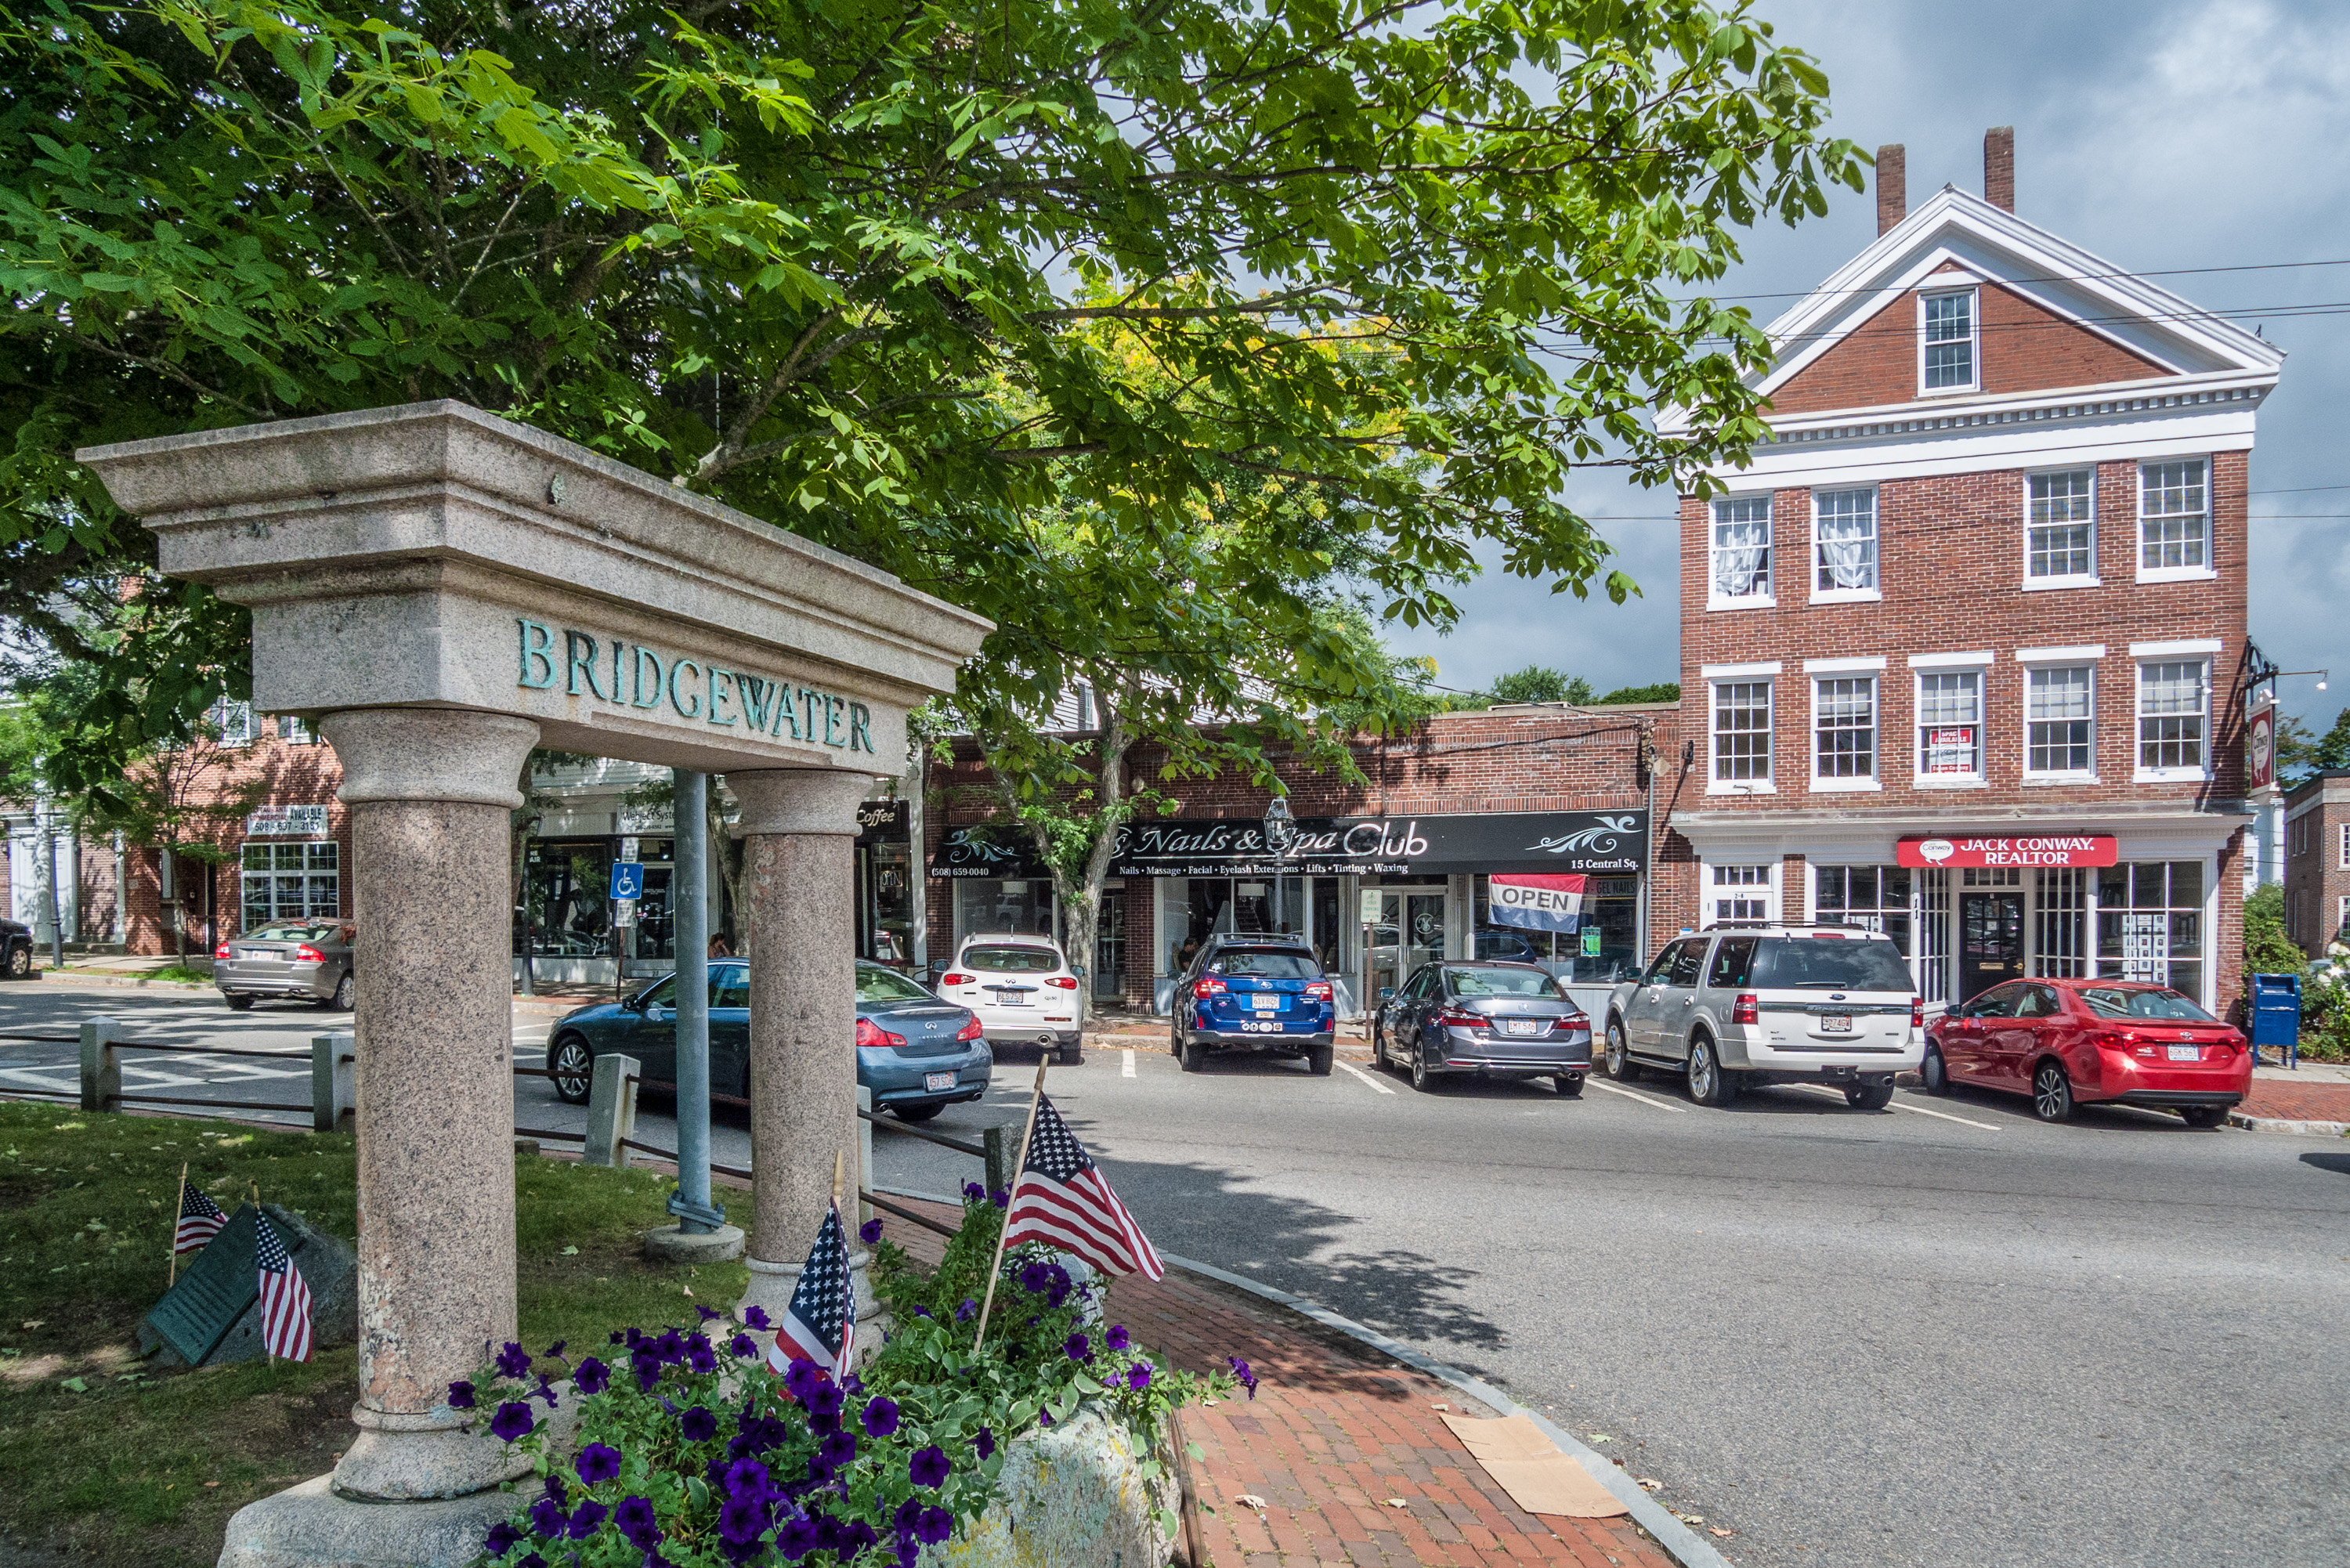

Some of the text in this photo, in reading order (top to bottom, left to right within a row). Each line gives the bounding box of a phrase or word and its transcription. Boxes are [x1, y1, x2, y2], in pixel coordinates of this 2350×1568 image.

[516, 617, 877, 754] BRIDGEWATER
[289, 807, 323, 821] AVAILABLE
[255, 822, 269, 831] 508
[1133, 825, 1231, 853] Nails
[1235, 829, 1264, 851] &
[1272, 826, 1338, 858] Spa
[1343, 821, 1428, 857] Club
[1960, 839, 2010, 852] JACK
[1922, 844, 1951, 852] Conway
[1571, 858, 1639, 870] 15 Central Sq.
[1984, 851, 2070, 865] REALTOR
[931, 867, 989, 877] (508) 659-0040
[1119, 862, 1408, 876] Nails Massage Facial Eyelash Extenions Lifts Tinting Waxing
[1596, 882, 1611, 894] GEL
[1613, 881, 1636, 894] NAILS
[1501, 887, 1569, 911] OPEN
